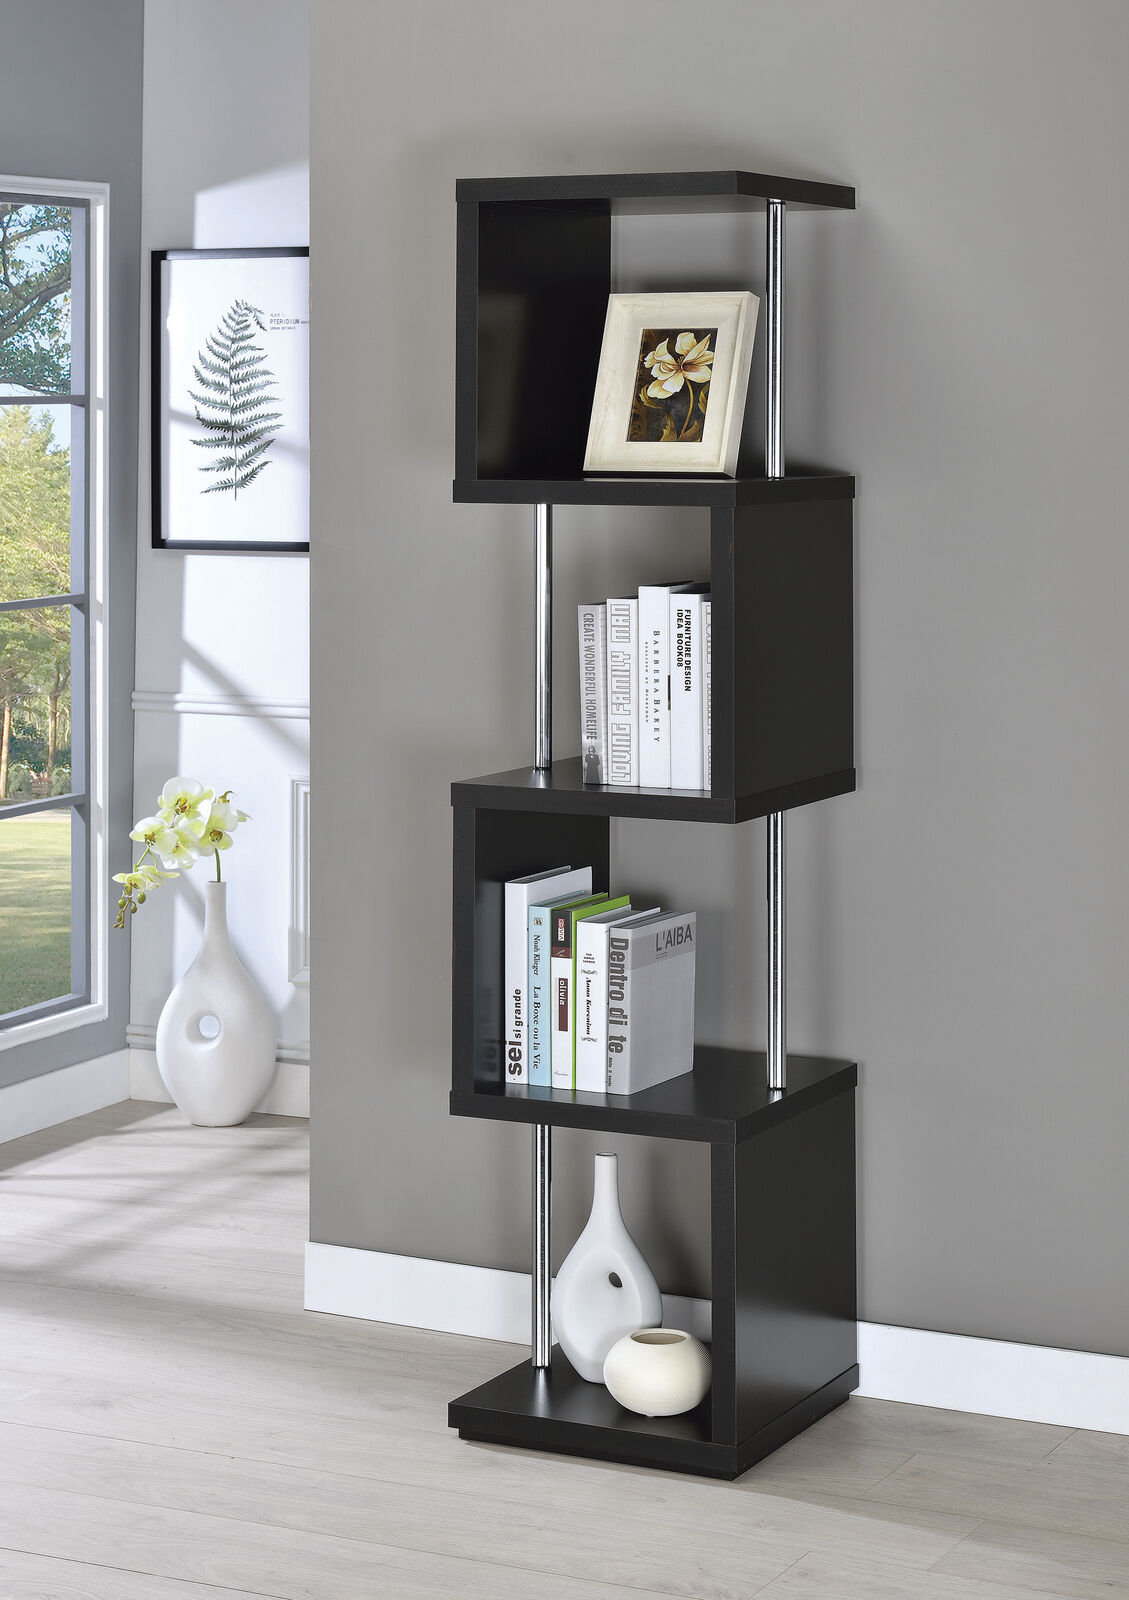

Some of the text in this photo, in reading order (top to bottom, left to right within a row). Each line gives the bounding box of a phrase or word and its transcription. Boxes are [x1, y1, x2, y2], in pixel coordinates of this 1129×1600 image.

[583, 612, 598, 740] CREATE WONDERFUL HOMELIFE
[610, 603, 632, 783] LOVING FAMILY MAN
[653, 699, 661, 743] BAREY
[532, 934, 541, 976] Noah Klieger
[559, 980, 567, 1006] olivia
[608, 937, 629, 1054] Dentro di te
[505, 988, 523, 1076] sei si grande
[533, 986, 541, 1069] La Boxe ou la Vie
